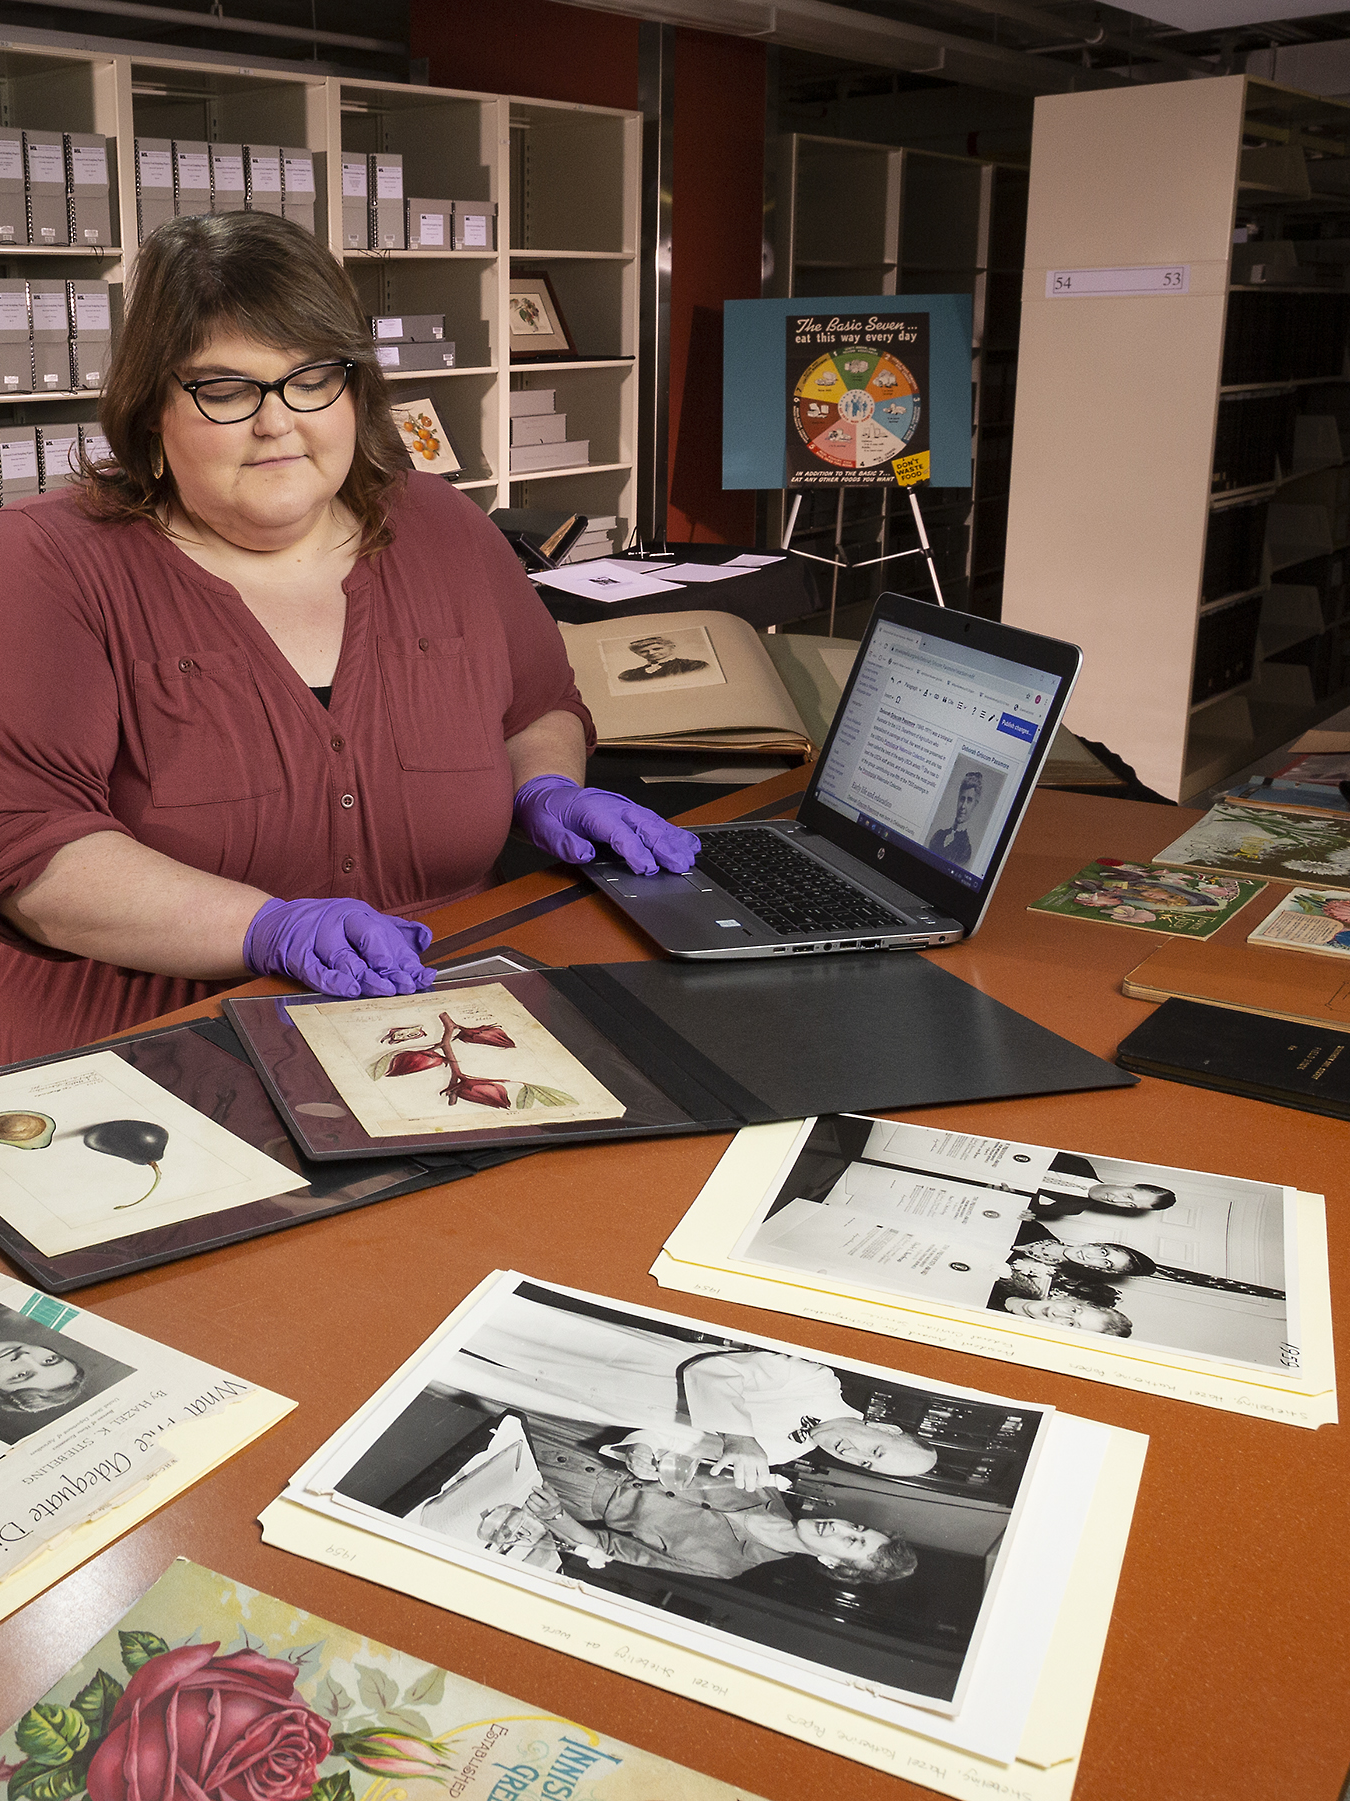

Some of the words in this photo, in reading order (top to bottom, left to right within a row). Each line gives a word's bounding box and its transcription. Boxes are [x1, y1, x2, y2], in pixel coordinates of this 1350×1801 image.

[1055, 277, 1071, 290] 54
[1163, 272, 1181, 286] 53
[796, 318, 821, 332] The
[826, 317, 861, 330] Basic
[795, 334, 810, 342] eat
[817, 332, 834, 342] this
[841, 334, 859, 343] way
[866, 334, 892, 342] every
[898, 331, 916, 342] day
[896, 457, 920, 470] DON'T
[896, 463, 924, 476] WASTE
[901, 470, 923, 481] FOOD
[1001, 719, 1015, 728] Publish
[961, 744, 976, 755] Deborah
[976, 750, 991, 761] Griscom
[990, 757, 1010, 769] Passmore
[849, 780, 862, 793] Early
[859, 785, 868, 795] life
[866, 789, 876, 799] and
[873, 792, 893, 808] education
[1278, 1341, 1300, 1370] 1959
[103, 1397, 119, 1408] United
[150, 1389, 167, 1402] By
[90, 1408, 102, 1416] States
[97, 1409, 113, 1420] Bureau
[110, 1400, 150, 1424] HAZEL
[63, 1417, 88, 1433] Department
[77, 1425, 90, 1433] Home
[93, 1427, 110, 1435] K.
[30, 1438, 54, 1455] Agriculture
[52, 1434, 76, 1449] Economics
[22, 1438, 93, 1483] STIEBELING
[29, 1453, 130, 1520] Adequate
[537, 1621, 572, 1643] work
[582, 1636, 602, 1653] at
[610, 1642, 677, 1679] Stiebeling
[689, 1673, 729, 1698] Hazel
[781, 1710, 828, 1737] Papers
[449, 1723, 509, 1799] ESTABLISHED
[906, 1753, 948, 1779] Hazel
